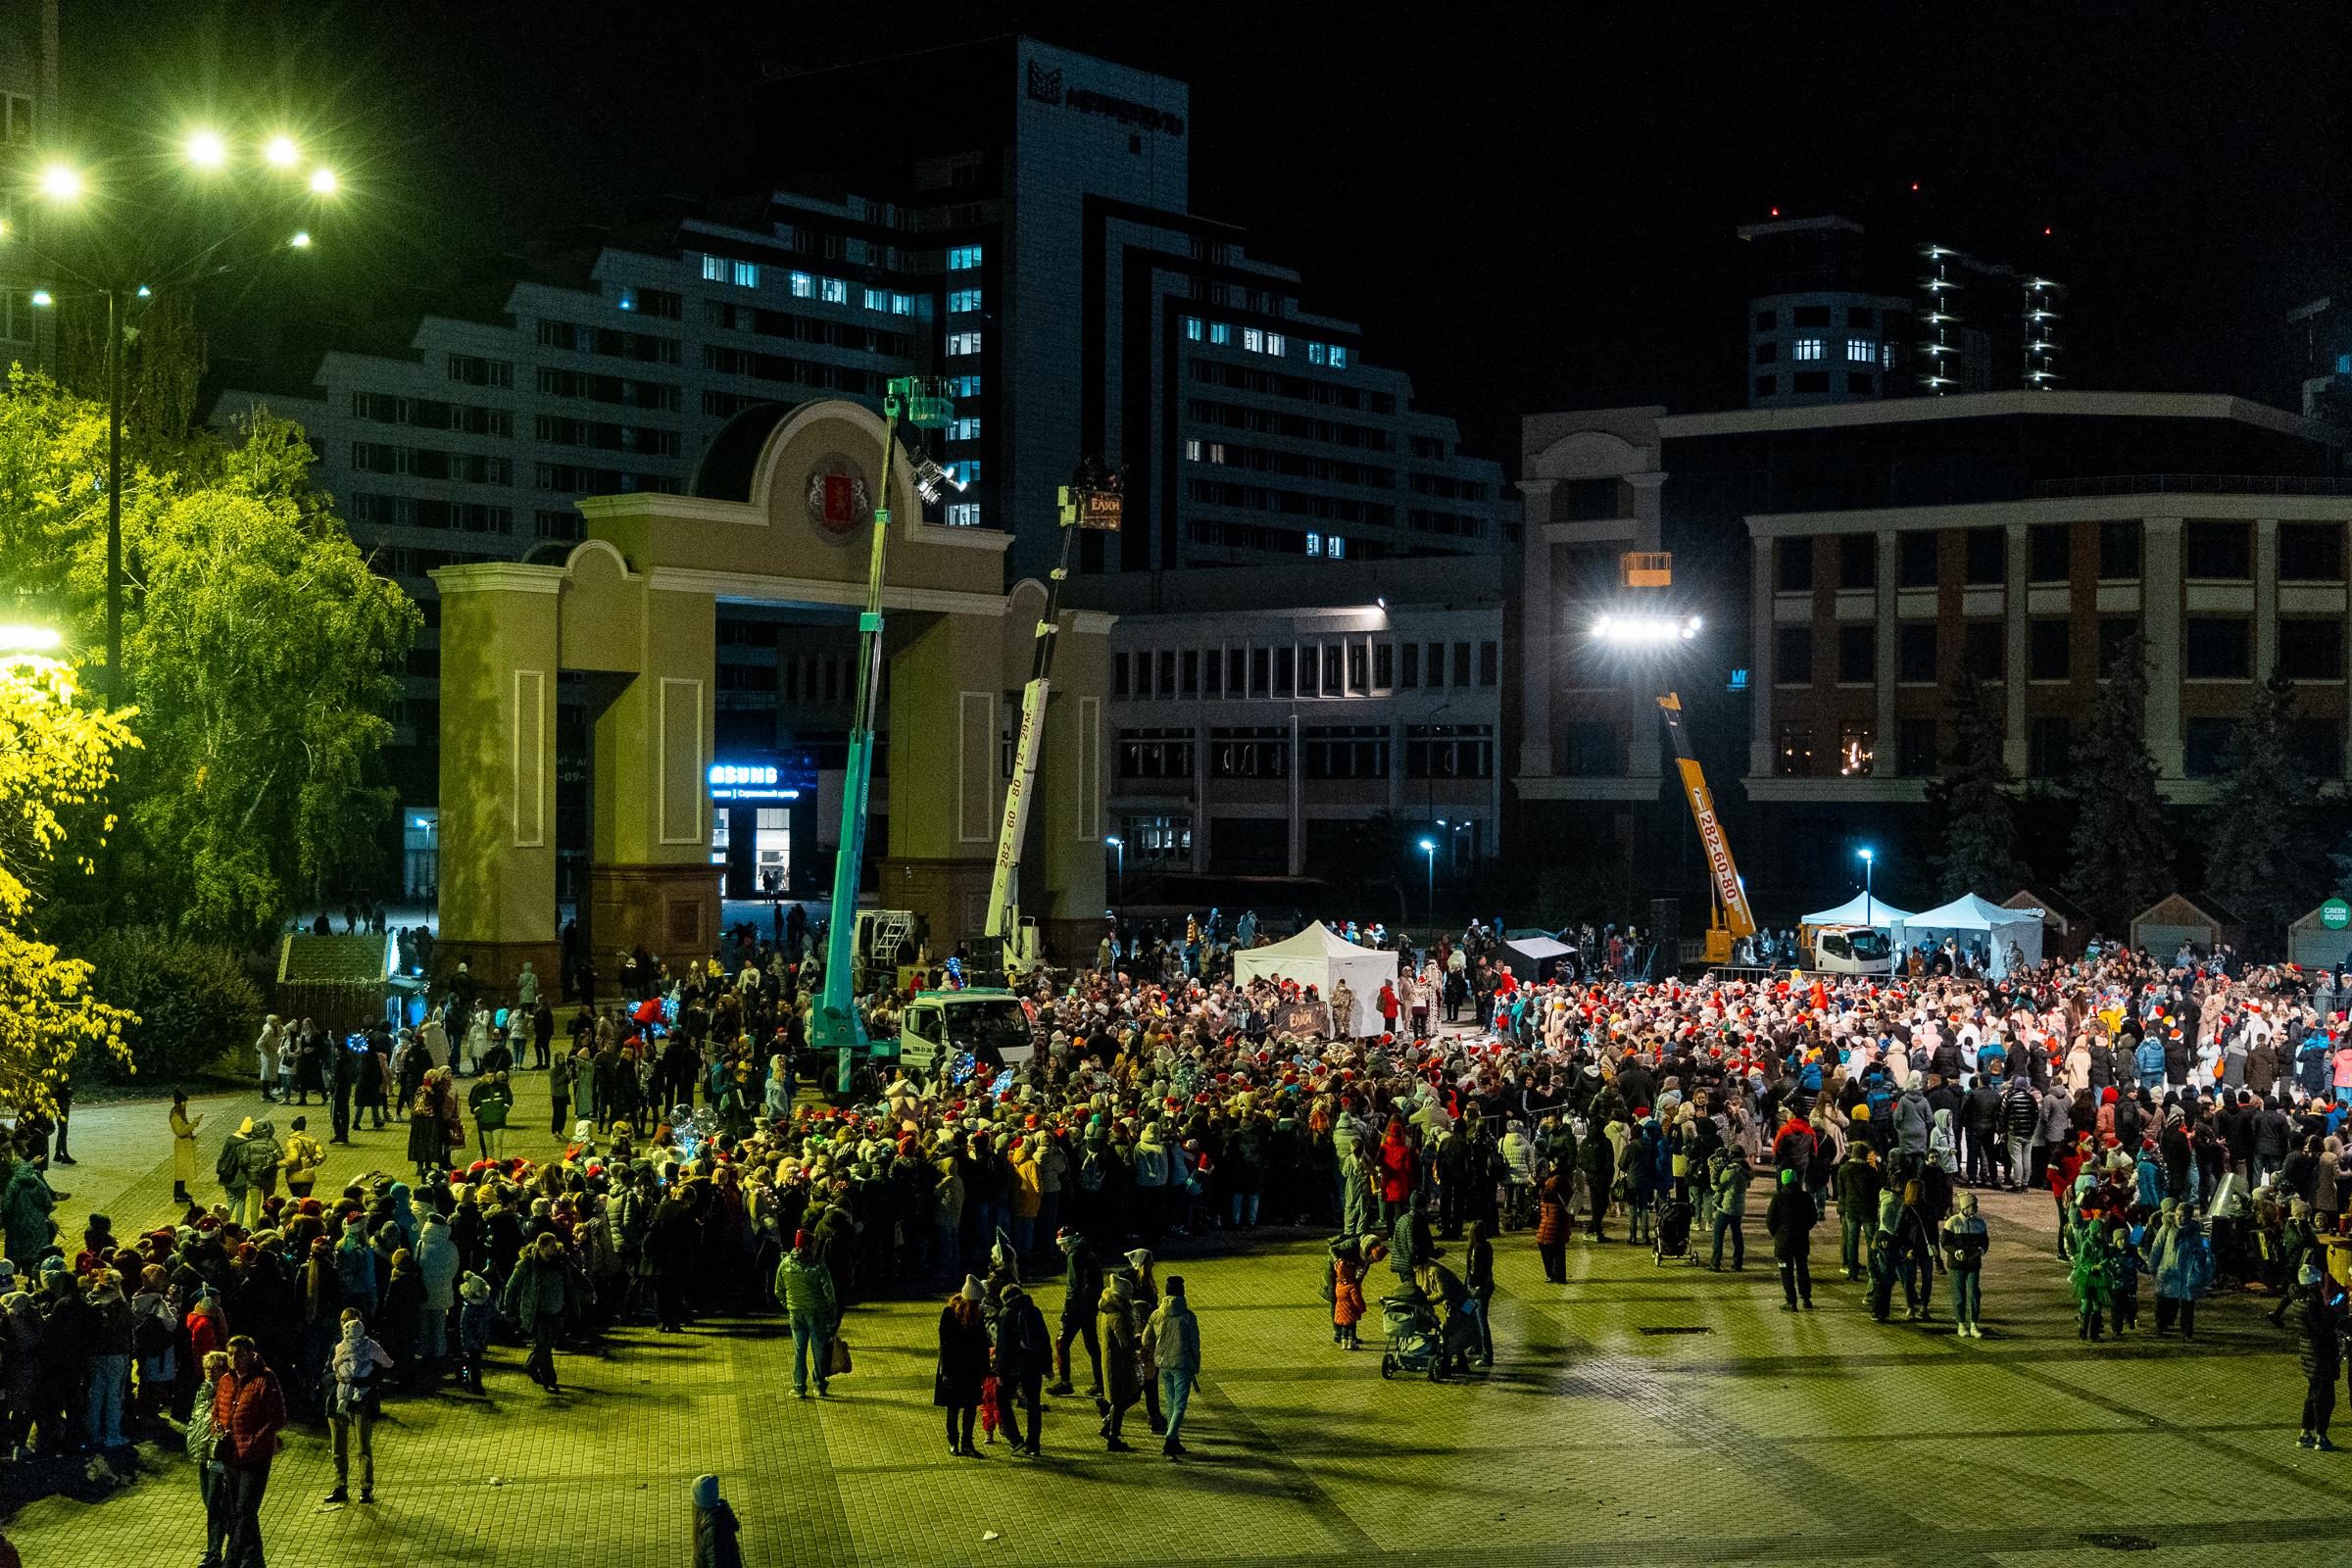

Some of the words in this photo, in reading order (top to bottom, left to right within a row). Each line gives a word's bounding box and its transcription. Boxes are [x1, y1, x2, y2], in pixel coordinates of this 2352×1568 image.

[1015, 752, 1025, 768] 12
[1012, 779, 1021, 797] 80
[1007, 810, 1016, 827] 60
[1000, 842, 1011, 869] 282
[1700, 814, 1737, 900] 282-60-80
